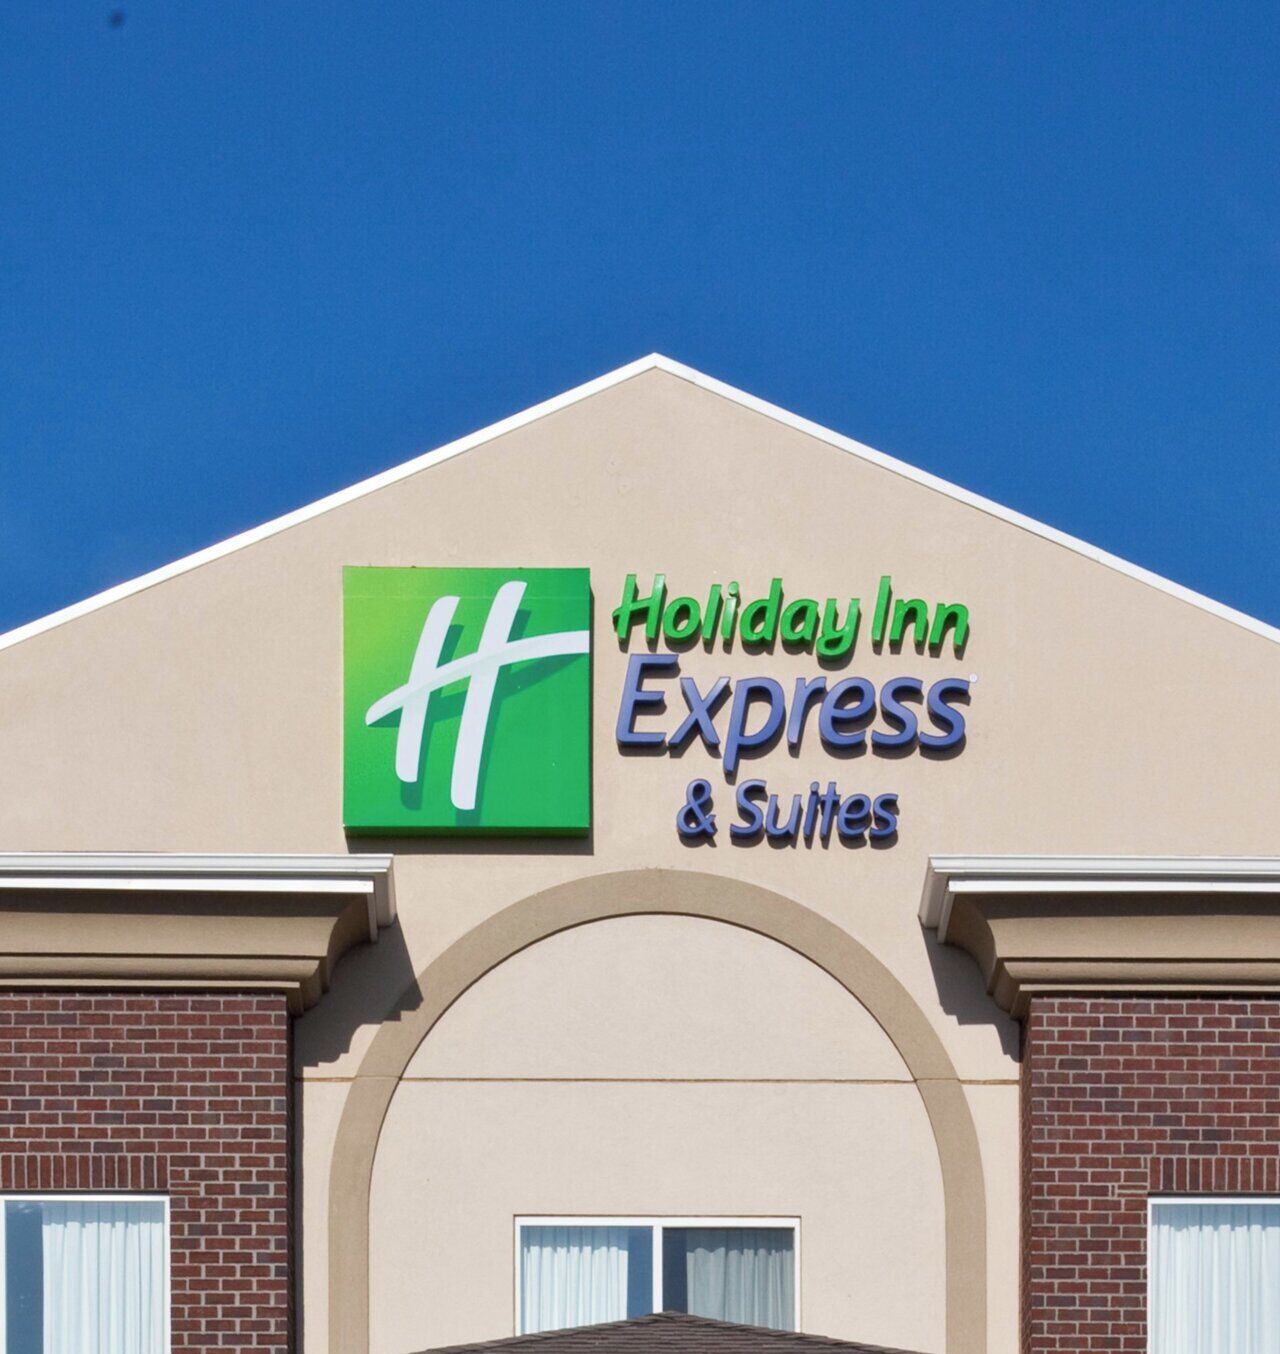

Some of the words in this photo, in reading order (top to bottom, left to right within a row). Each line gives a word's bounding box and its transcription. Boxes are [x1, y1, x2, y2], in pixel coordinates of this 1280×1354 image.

[613, 573, 861, 661] Holiday
[871, 575, 970, 649] Inn
[616, 653, 970, 774] Express
[676, 778, 716, 839] &
[730, 778, 899, 840] Suites
